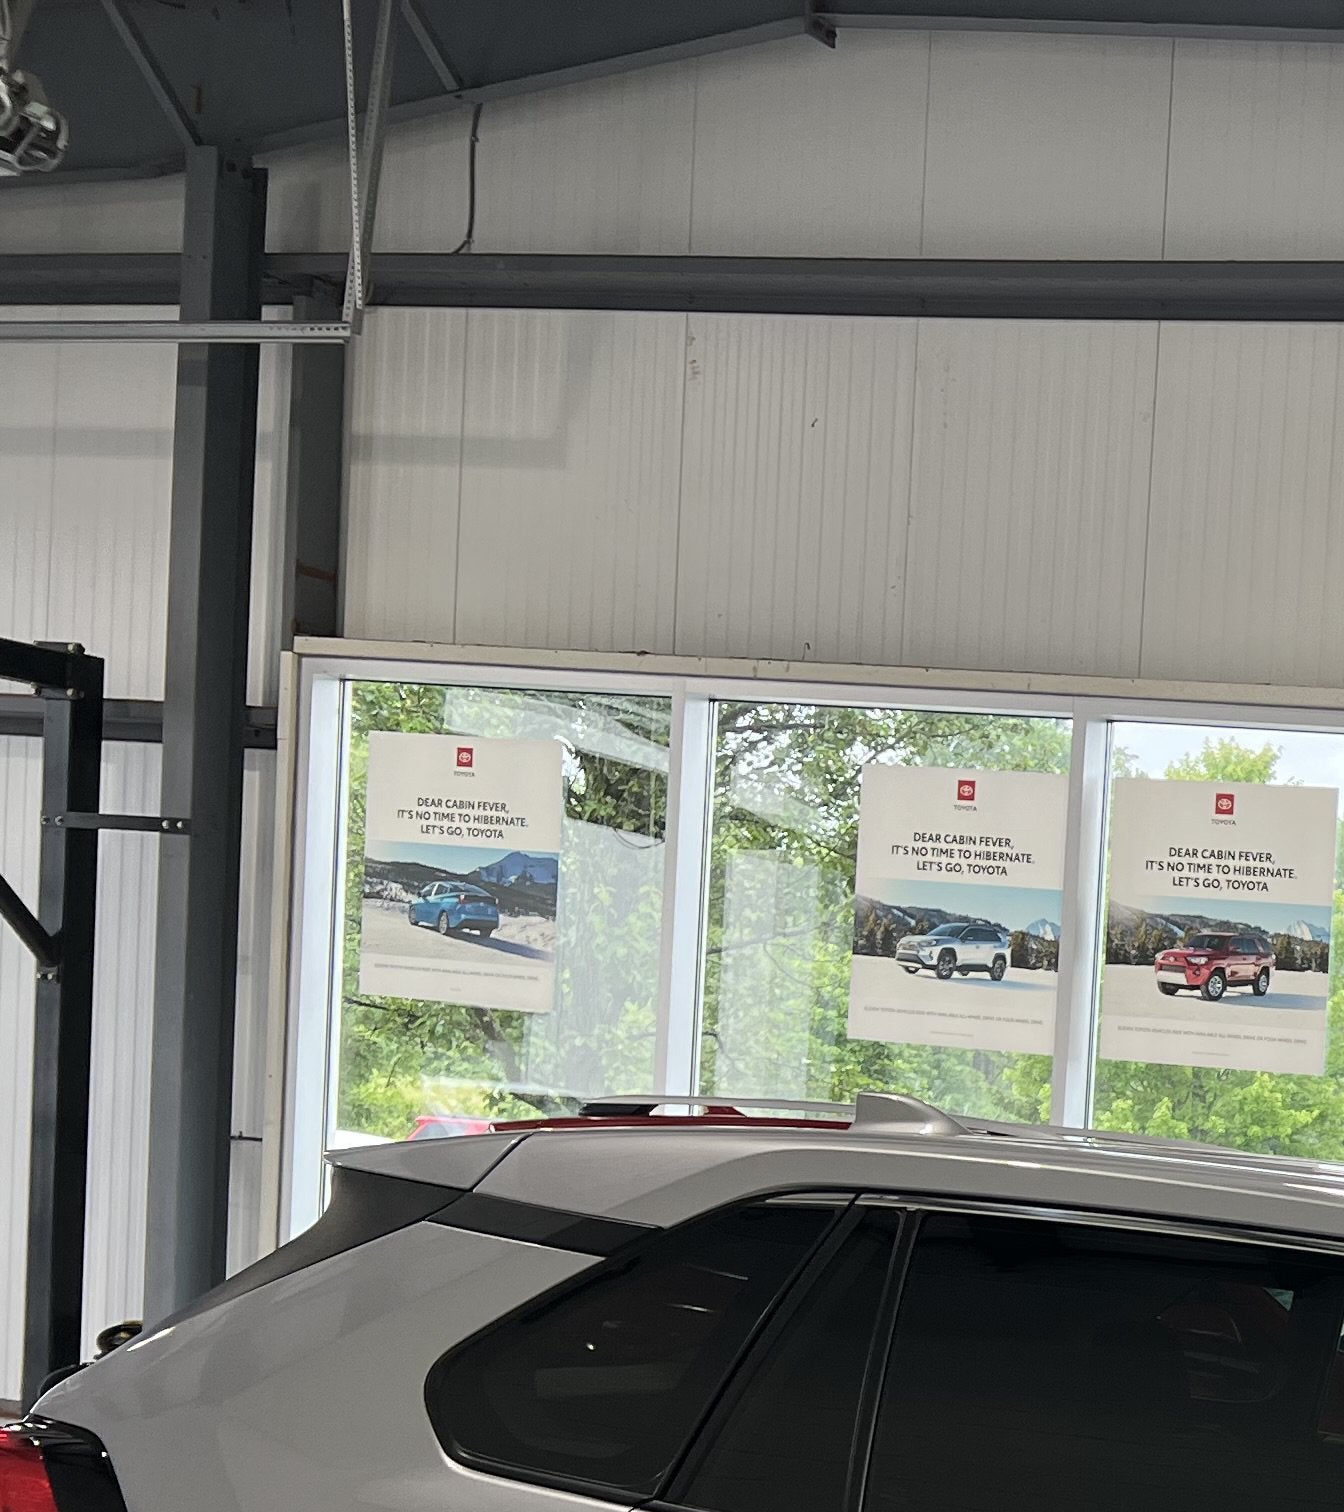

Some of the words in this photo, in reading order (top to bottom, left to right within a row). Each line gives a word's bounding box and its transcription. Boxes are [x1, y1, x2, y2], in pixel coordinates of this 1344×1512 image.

[417, 797, 443, 808] DEAR
[445, 799, 475, 811] CABIN
[477, 801, 509, 814] FEVER,
[953, 804, 978, 812] TOYOTA
[397, 809, 414, 820] IT'S
[415, 810, 431, 821] NO
[433, 811, 456, 823] TIME
[458, 813, 471, 823] TO
[473, 814, 529, 828] HIBERNATE.
[1211, 818, 1237, 826] TOYOTA
[420, 824, 445, 835] LET'S
[446, 826, 464, 838] GO,
[466, 827, 504, 839] TOYOTA
[913, 832, 942, 844] DEAR
[944, 833, 977, 846] CABIN
[979, 836, 1015, 850] FEVER,
[891, 845, 909, 856] IT'S
[911, 846, 929, 857] NO
[930, 847, 955, 859] TIME
[958, 849, 972, 860] TO
[974, 851, 1035, 864] HIBERNATE.
[1168, 847, 1199, 859] DEAR
[1201, 849, 1236, 861] CABIN
[1238, 851, 1276, 865] FEVER,
[916, 860, 943, 872] LET'S
[945, 862, 964, 875] GO,
[967, 864, 1008, 876] TOYOTA
[1145, 860, 1164, 871] IT'S
[1167, 861, 1185, 873] NO
[1187, 862, 1213, 874] TIME
[1215, 864, 1230, 876] TO
[1233, 865, 1298, 880] HIBERNATE.
[1172, 876, 1200, 888] LET'S
[1202, 878, 1223, 891] GO,
[1226, 880, 1269, 892] TOYOTA
